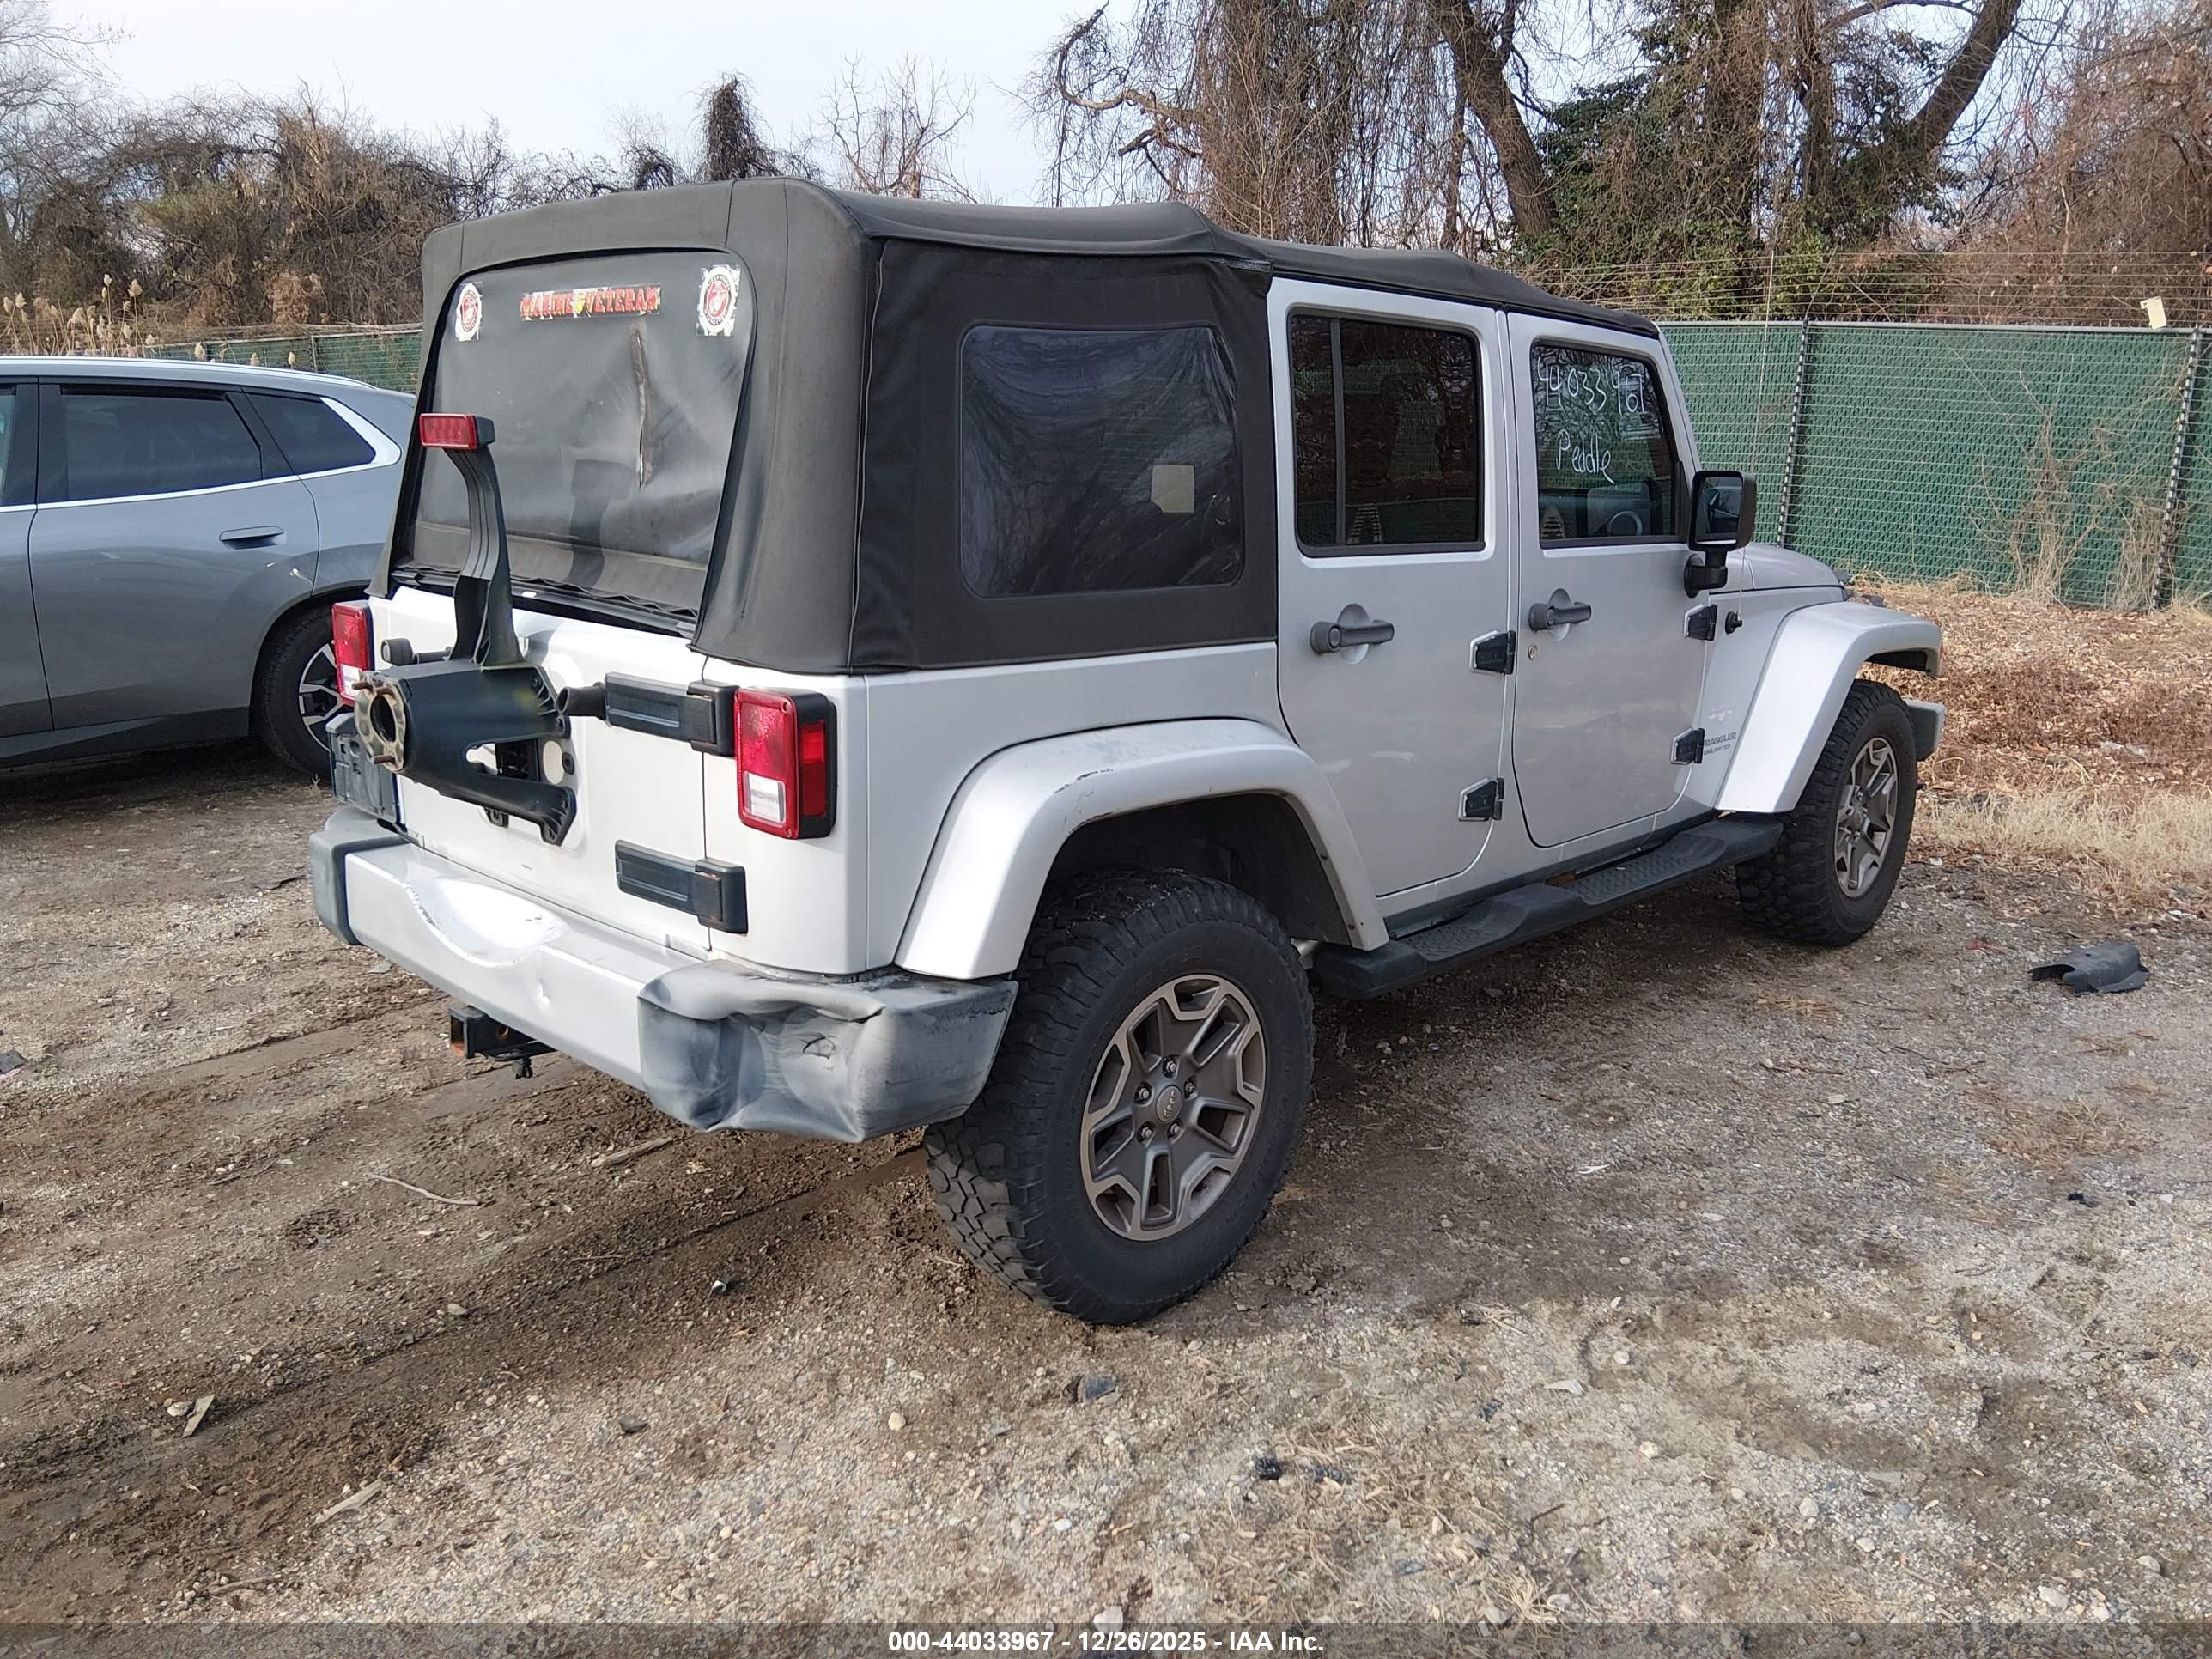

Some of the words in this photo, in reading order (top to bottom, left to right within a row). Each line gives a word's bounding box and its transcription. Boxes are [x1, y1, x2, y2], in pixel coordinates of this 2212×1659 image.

[520, 292, 574, 318] MARINE
[586, 287, 659, 315] VETERAN
[1556, 429, 1614, 484] Peddle
[1705, 732, 1736, 746] RANGLER
